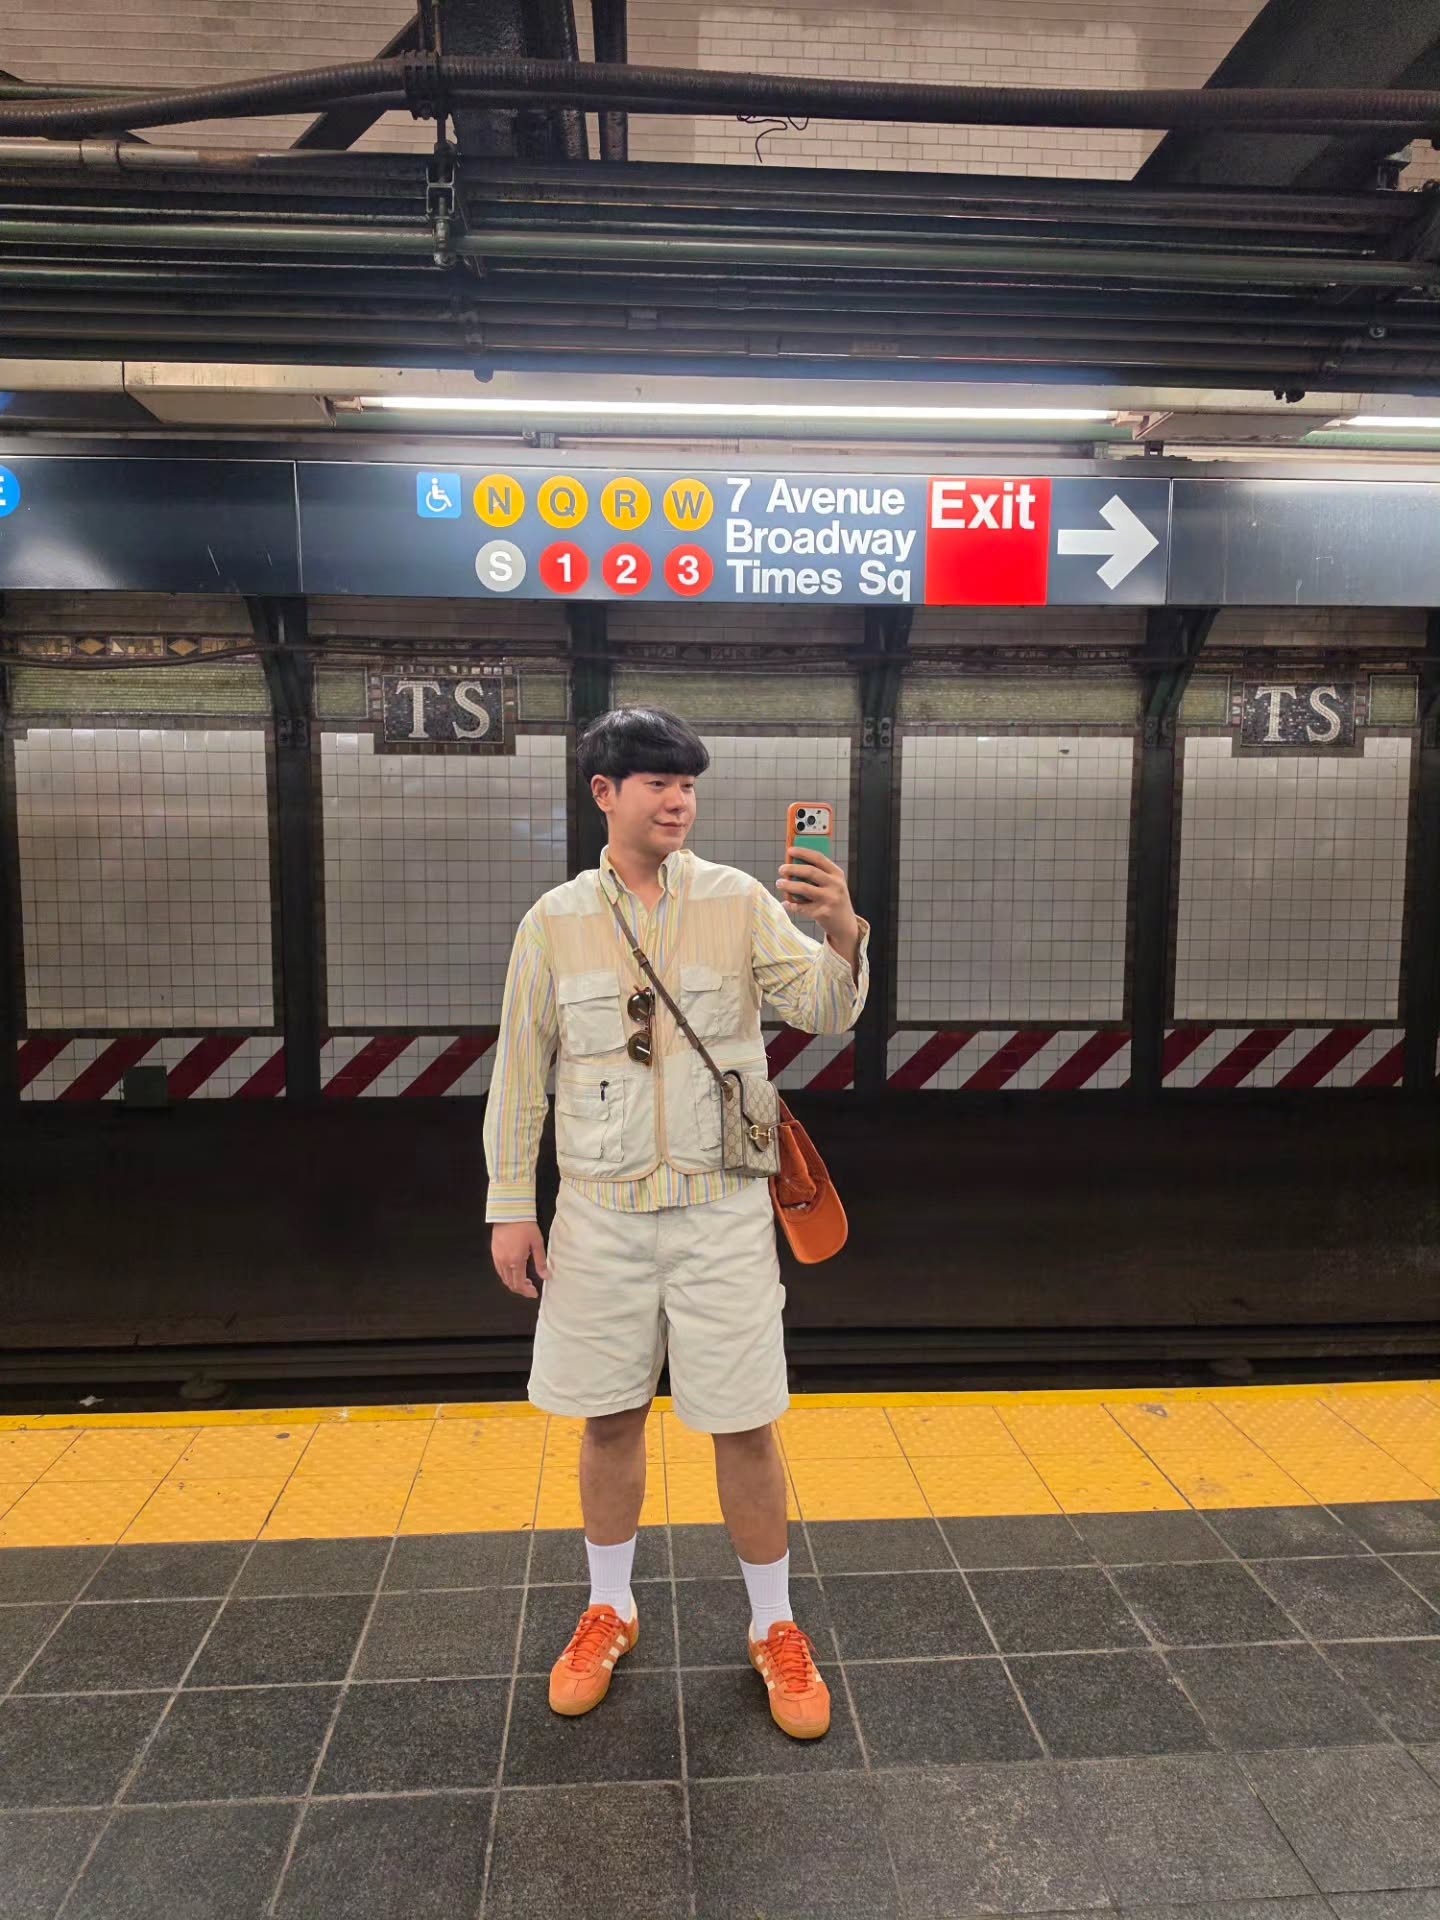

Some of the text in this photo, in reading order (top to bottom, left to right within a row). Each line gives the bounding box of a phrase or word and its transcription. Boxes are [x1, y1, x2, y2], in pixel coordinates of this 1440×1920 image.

[488, 487, 705, 519] N Q R W
[726, 477, 905, 515] 7 Avenue
[931, 480, 1036, 530] Exit
[726, 518, 916, 561] Broadway
[489, 551, 699, 586] S 1 2 3
[726, 559, 911, 602] Times Sq
